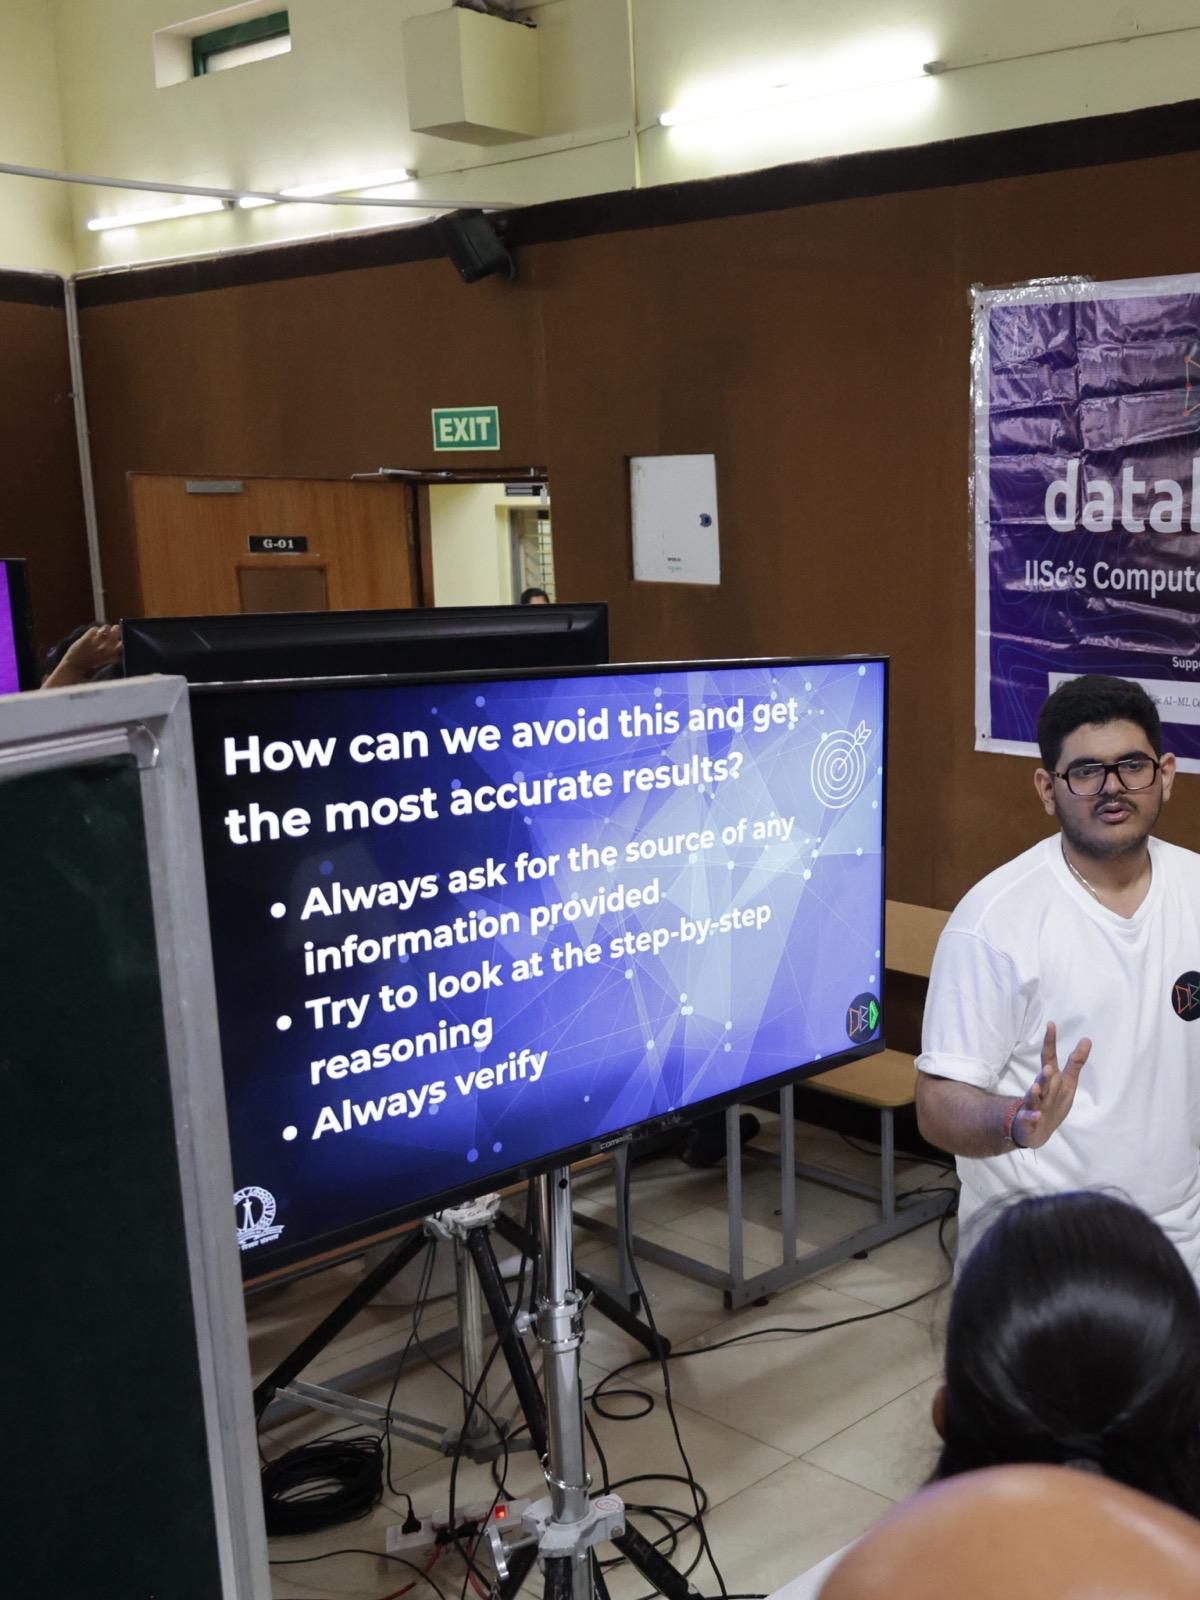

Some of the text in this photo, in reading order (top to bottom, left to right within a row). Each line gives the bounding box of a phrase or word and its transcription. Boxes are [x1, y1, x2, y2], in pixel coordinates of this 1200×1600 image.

[439, 416, 491, 442] EXIT
[262, 538, 294, 549] G-01
[1024, 559, 1087, 591] IISc's
[224, 697, 799, 776] How can we avoid this and get
[224, 751, 743, 844] the most accurate results?
[301, 815, 796, 921] Always ask for the source of any
[304, 878, 660, 976] information provided
[305, 904, 772, 1029] Try to look at the step-by-step
[310, 1016, 493, 1085] reasoning
[311, 1049, 548, 1140] Always verify
